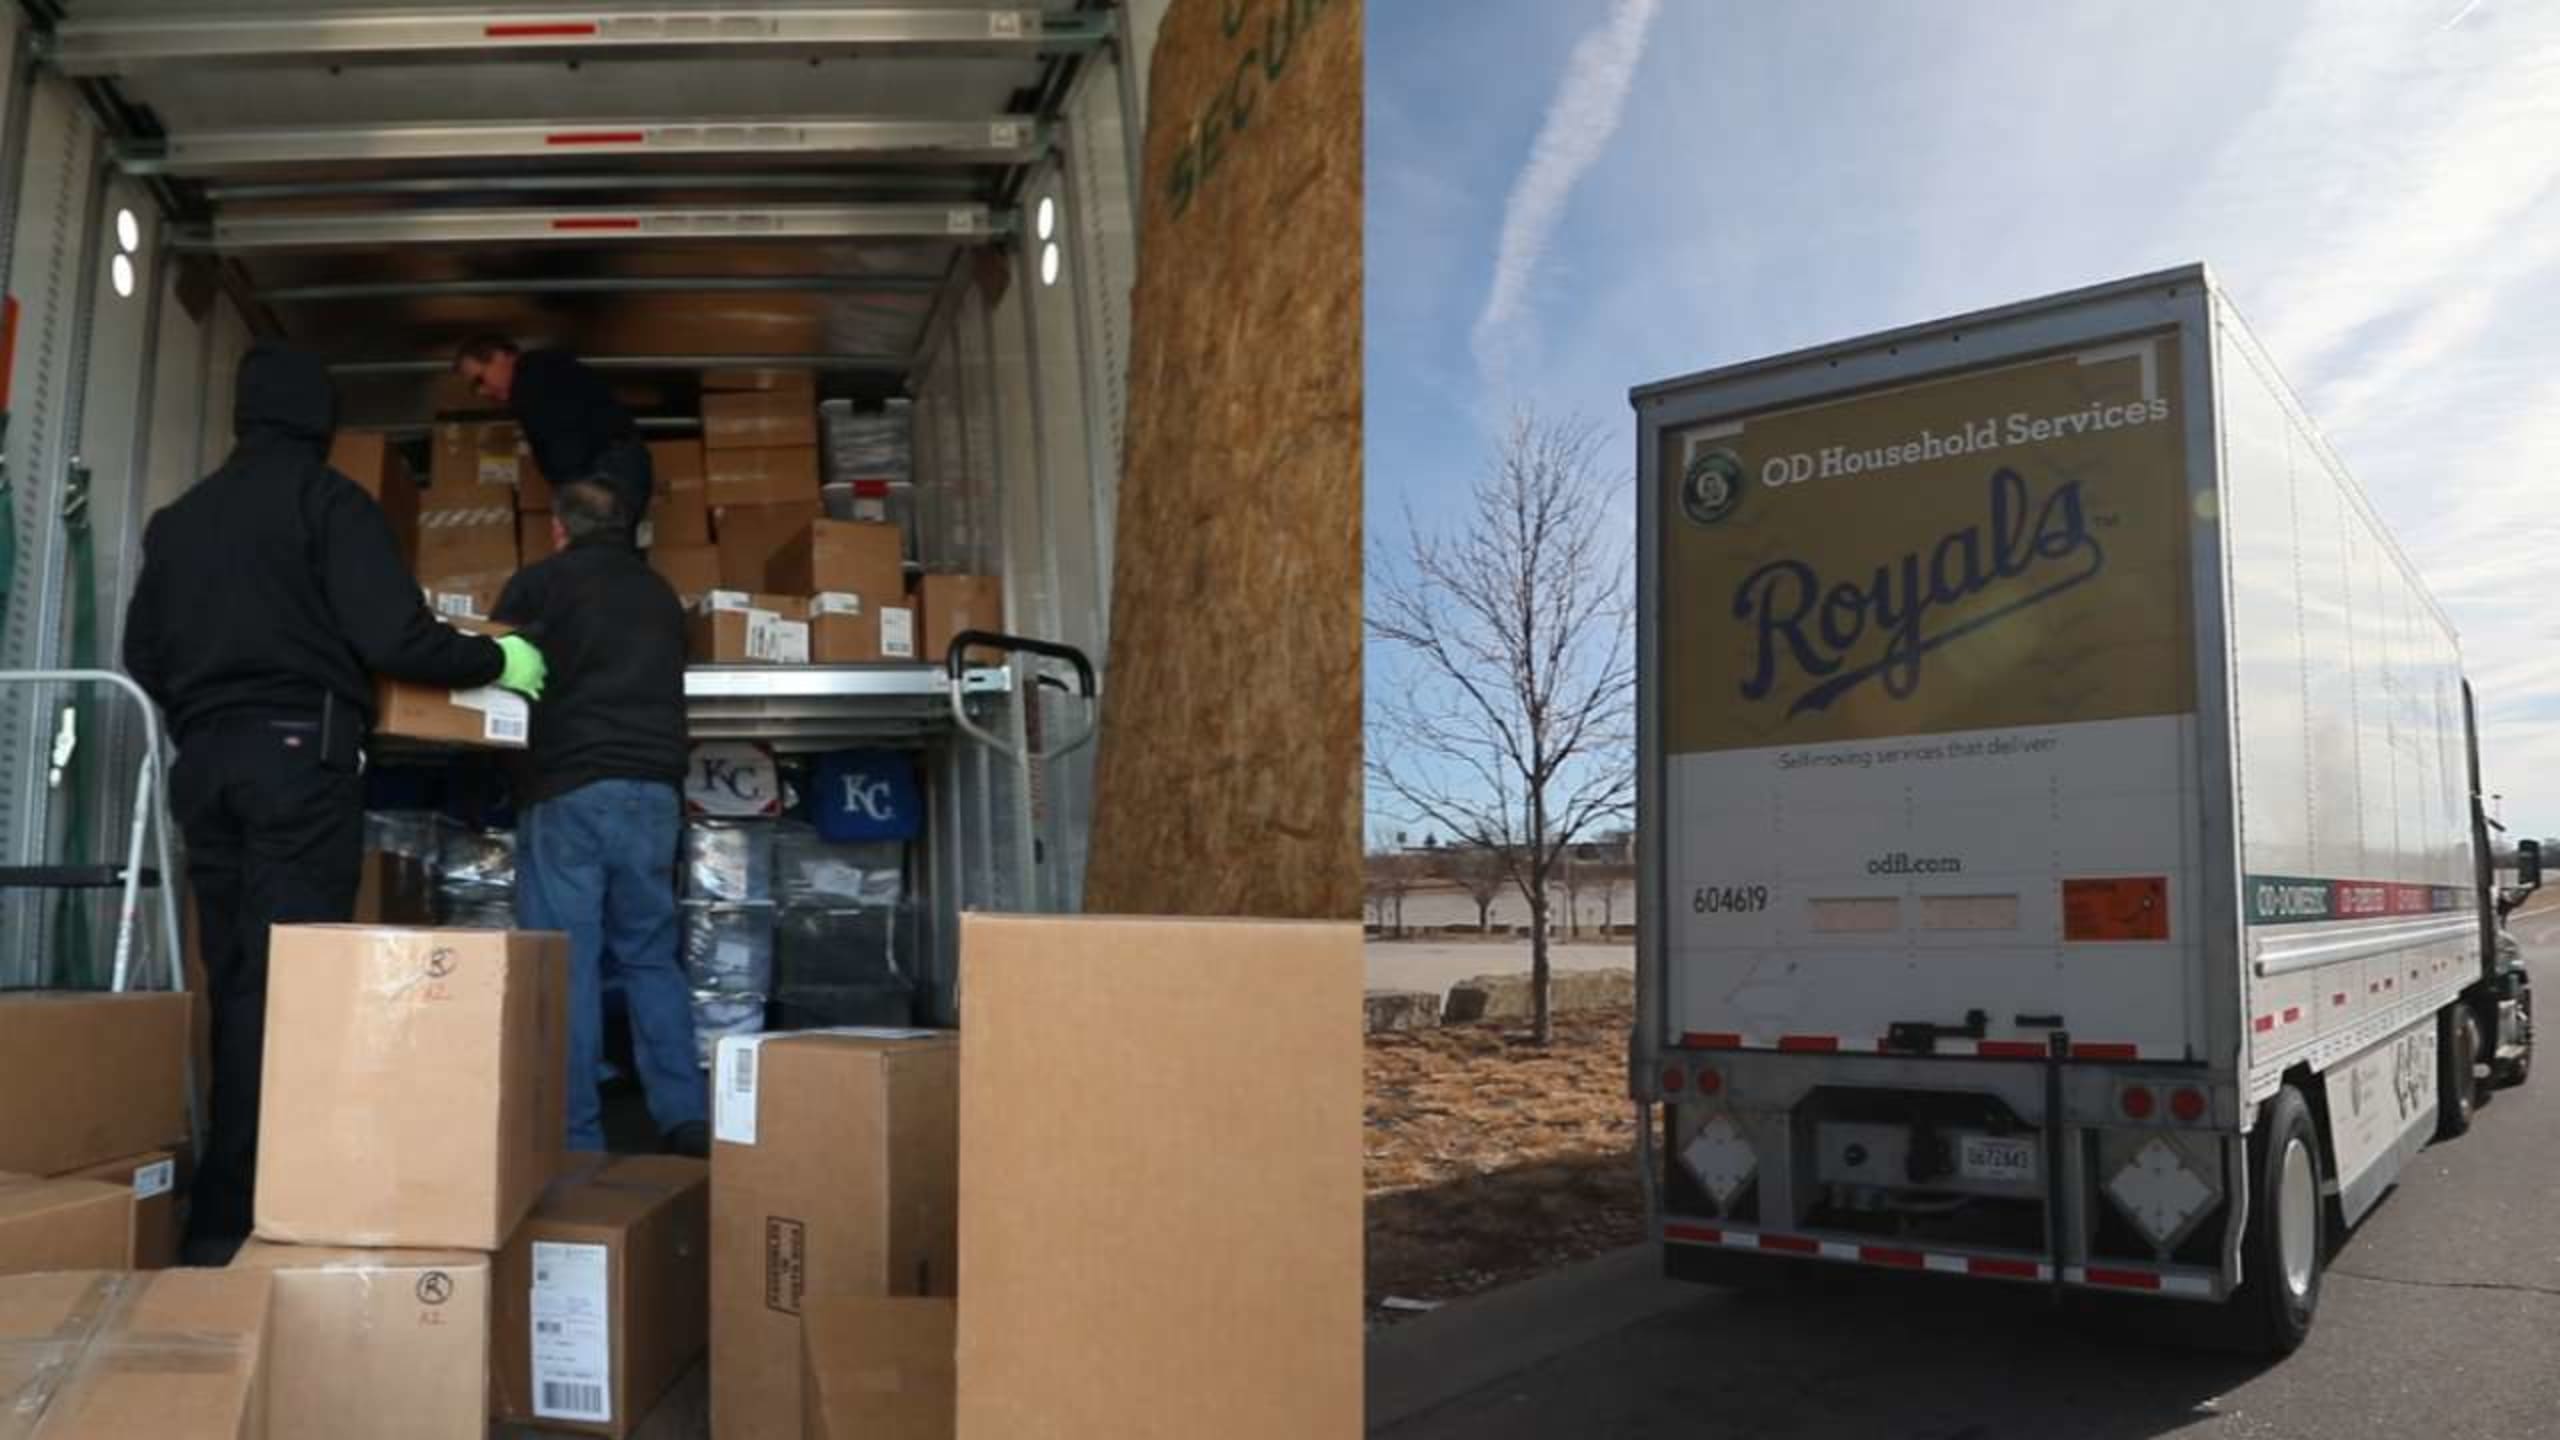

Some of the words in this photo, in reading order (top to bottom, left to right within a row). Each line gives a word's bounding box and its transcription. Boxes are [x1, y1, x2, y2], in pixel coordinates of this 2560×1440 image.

[1760, 455, 1815, 489] OD
[1818, 419, 1999, 480] Household
[2005, 396, 2169, 446] Services
[1733, 466, 2096, 703] Royals
[843, 773, 899, 821] KC
[1692, 885, 1768, 914] 604619
